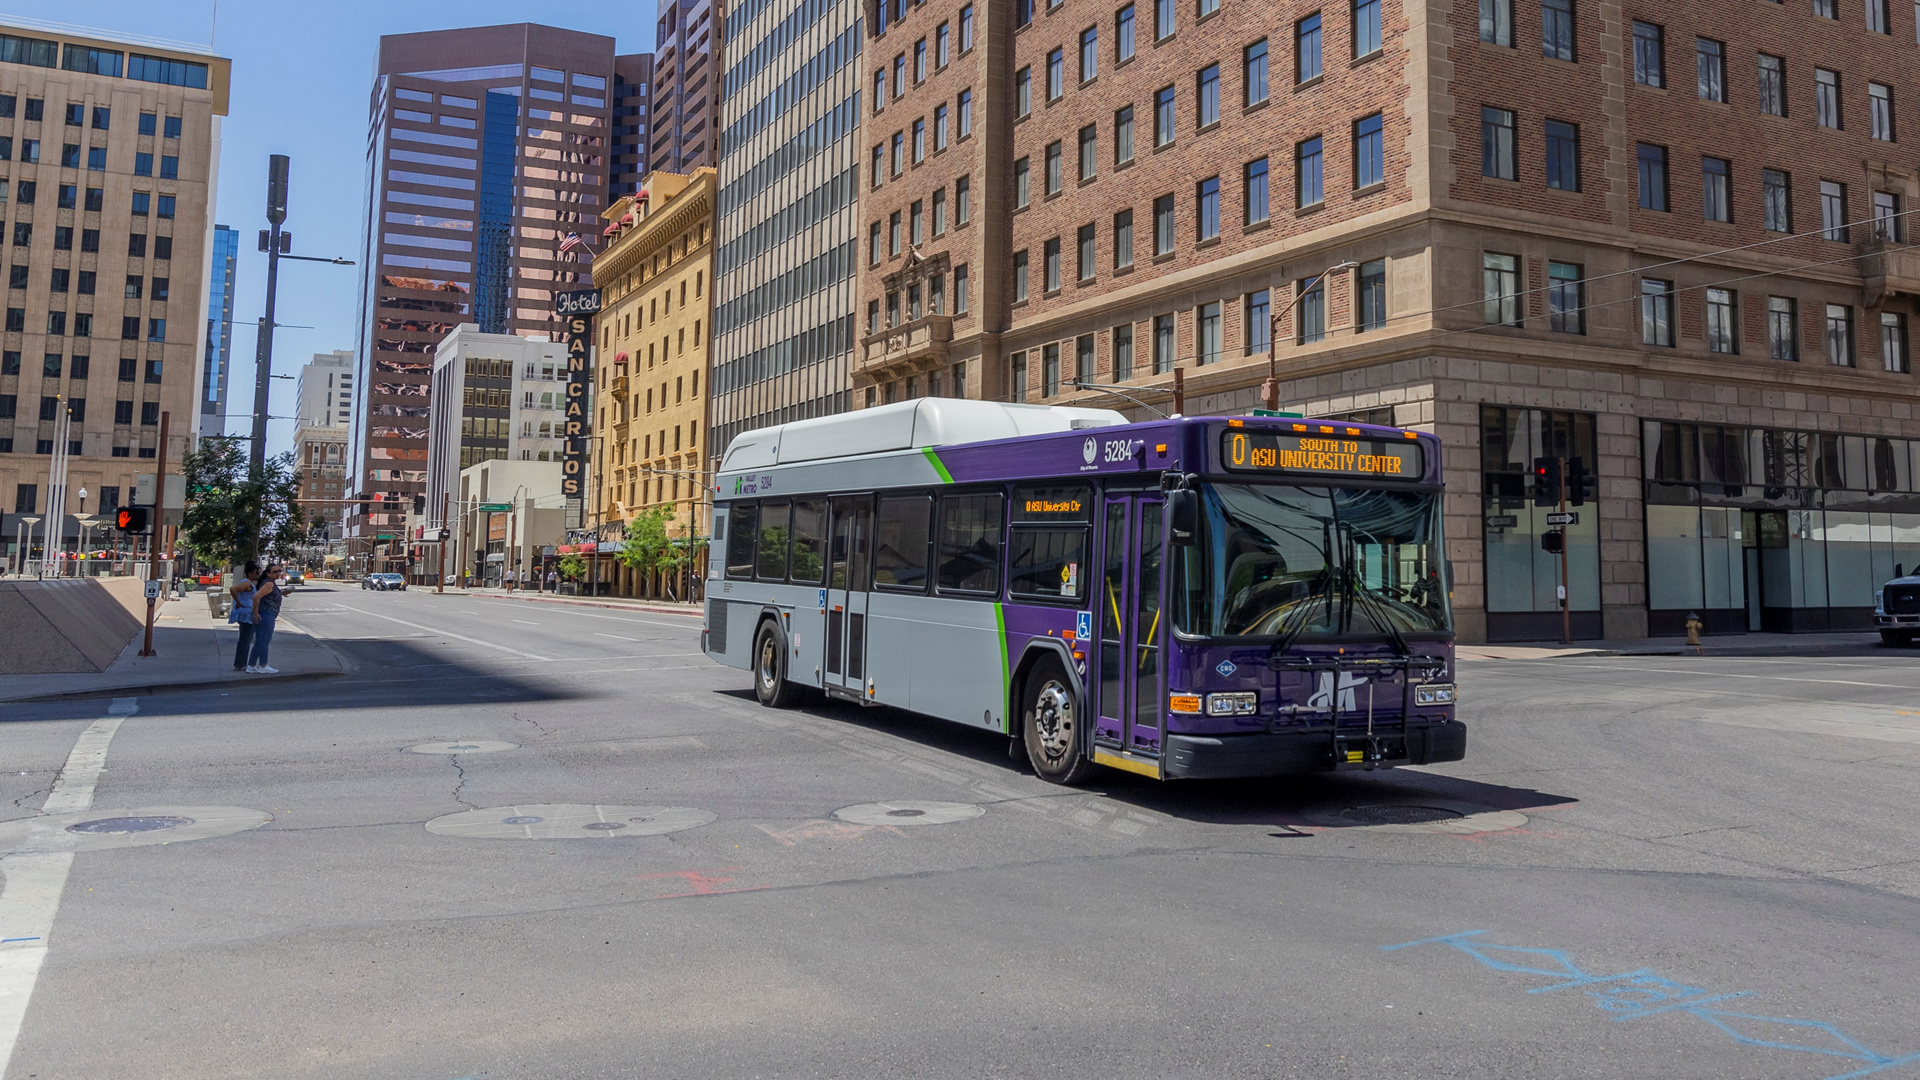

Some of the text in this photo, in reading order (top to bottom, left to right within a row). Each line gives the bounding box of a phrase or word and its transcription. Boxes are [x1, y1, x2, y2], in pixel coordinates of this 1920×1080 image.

[558, 292, 600, 312] Hotel
[570, 319, 586, 372] SAN
[564, 382, 583, 494] CARLOS
[1299, 438, 1358, 454] SOUTH TO
[1104, 439, 1132, 463] 5284
[1251, 448, 1276, 467] ASU
[1280, 450, 1355, 471] UNIVERSITY
[1357, 454, 1401, 474] CENTER
[743, 484, 757, 494] METRO
[760, 475, 773, 490] 5284
[1031, 500, 1043, 512] ASU
[1043, 500, 1070, 512] University
[1070, 499, 1081, 512] Ctr
